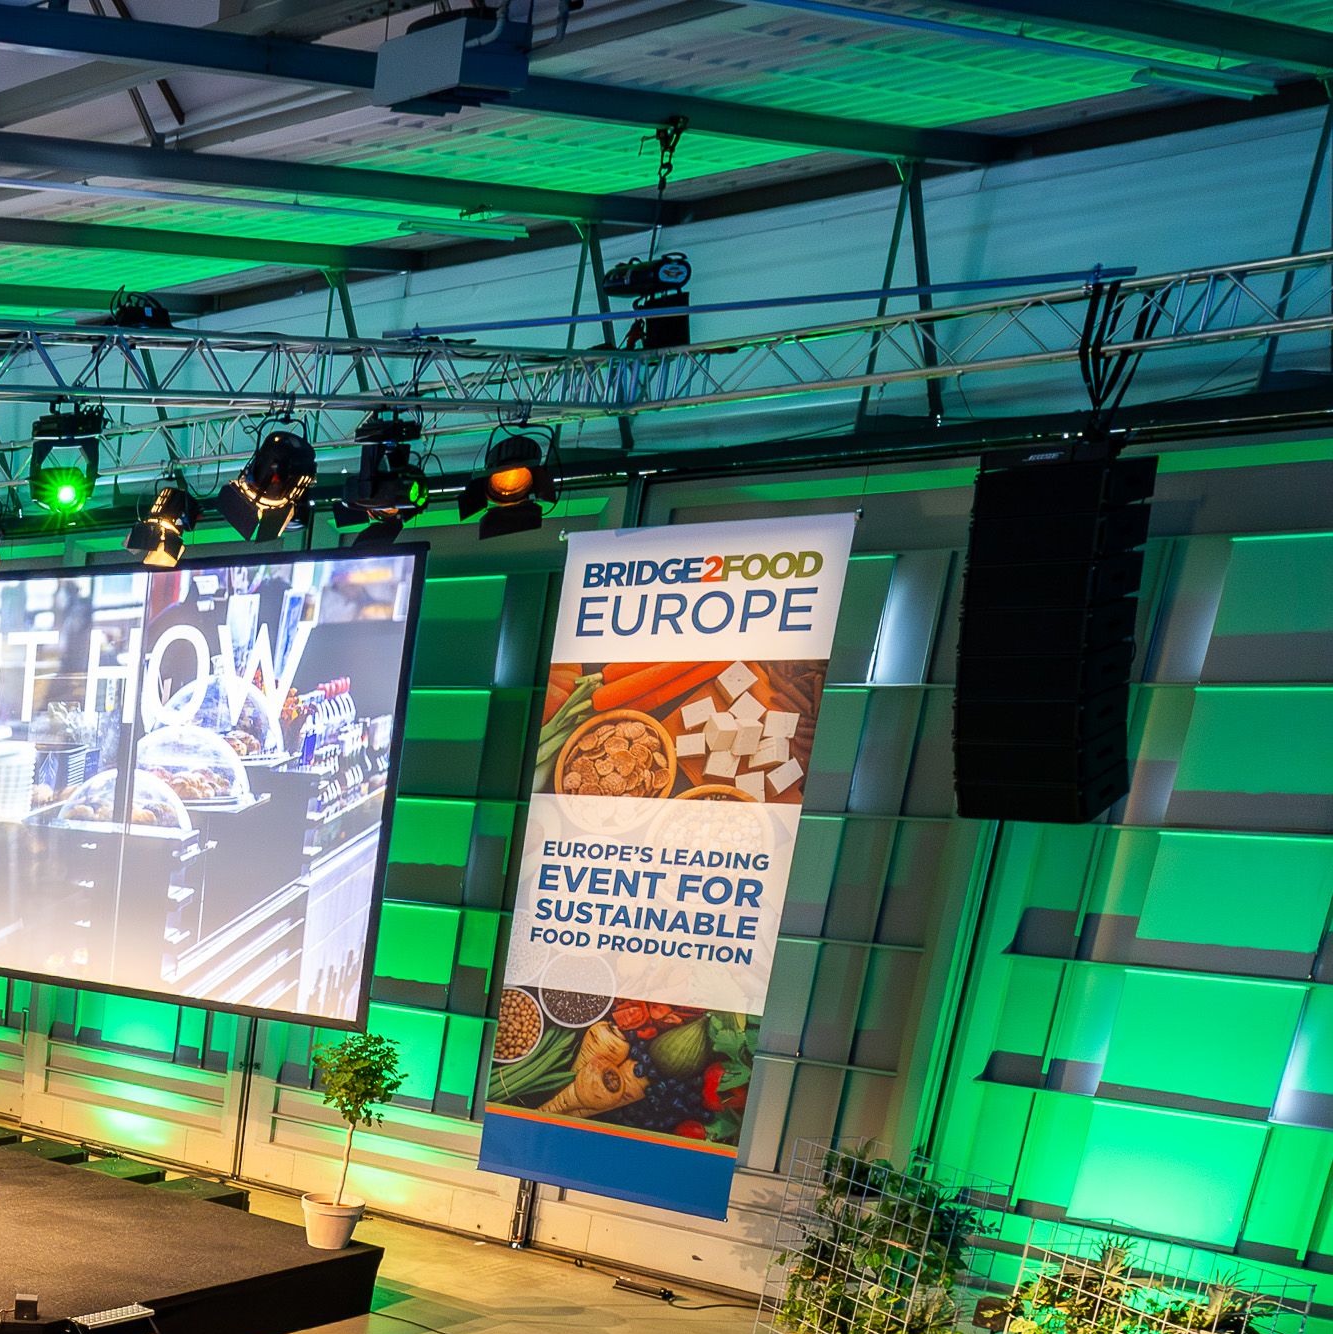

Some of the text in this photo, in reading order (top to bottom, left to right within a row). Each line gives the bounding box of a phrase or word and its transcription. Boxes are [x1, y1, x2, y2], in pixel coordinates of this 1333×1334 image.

[583, 550, 824, 589] BRIDGE2FOOD
[575, 587, 819, 637] EUROPE
[84, 623, 315, 725] HOW
[543, 840, 770, 871] EUROPE'S LEADING
[538, 863, 764, 908] EVENT FOR
[534, 898, 759, 941] SUSTAINABLE
[530, 926, 753, 965] FOOD PRODUCTION
